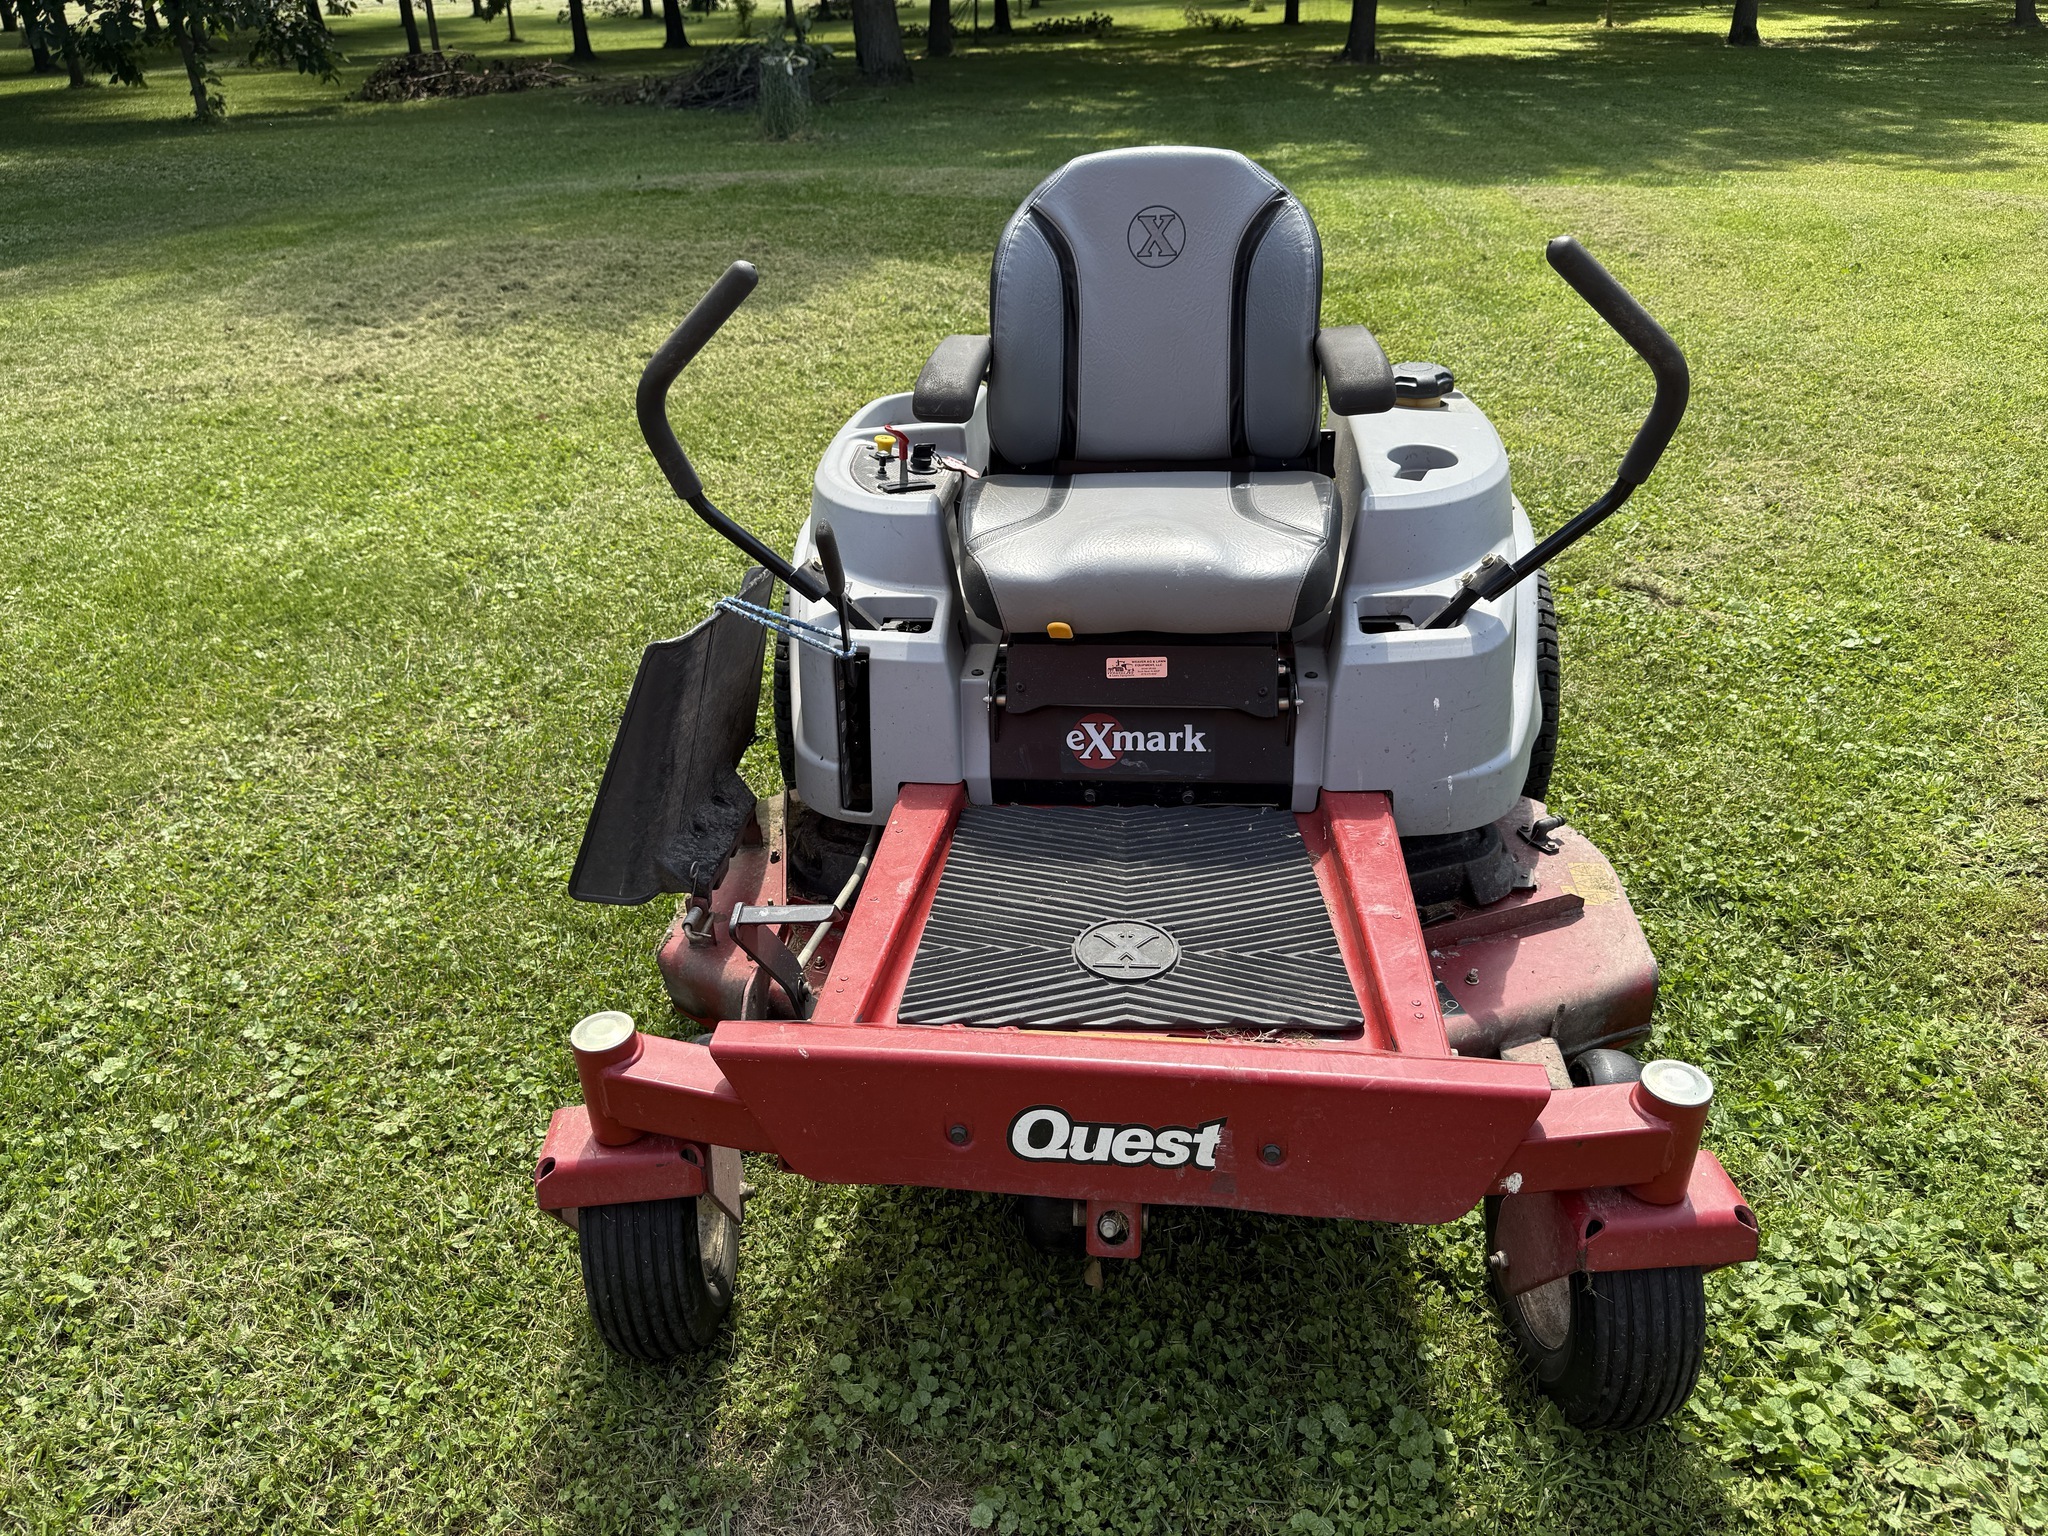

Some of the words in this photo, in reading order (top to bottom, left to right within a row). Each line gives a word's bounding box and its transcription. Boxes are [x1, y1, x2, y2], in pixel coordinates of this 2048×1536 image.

[1137, 214, 1177, 257] X
[1066, 722, 1207, 760] eXmark
[1093, 932, 1161, 969] X
[1011, 1108, 1221, 1168] Quest
